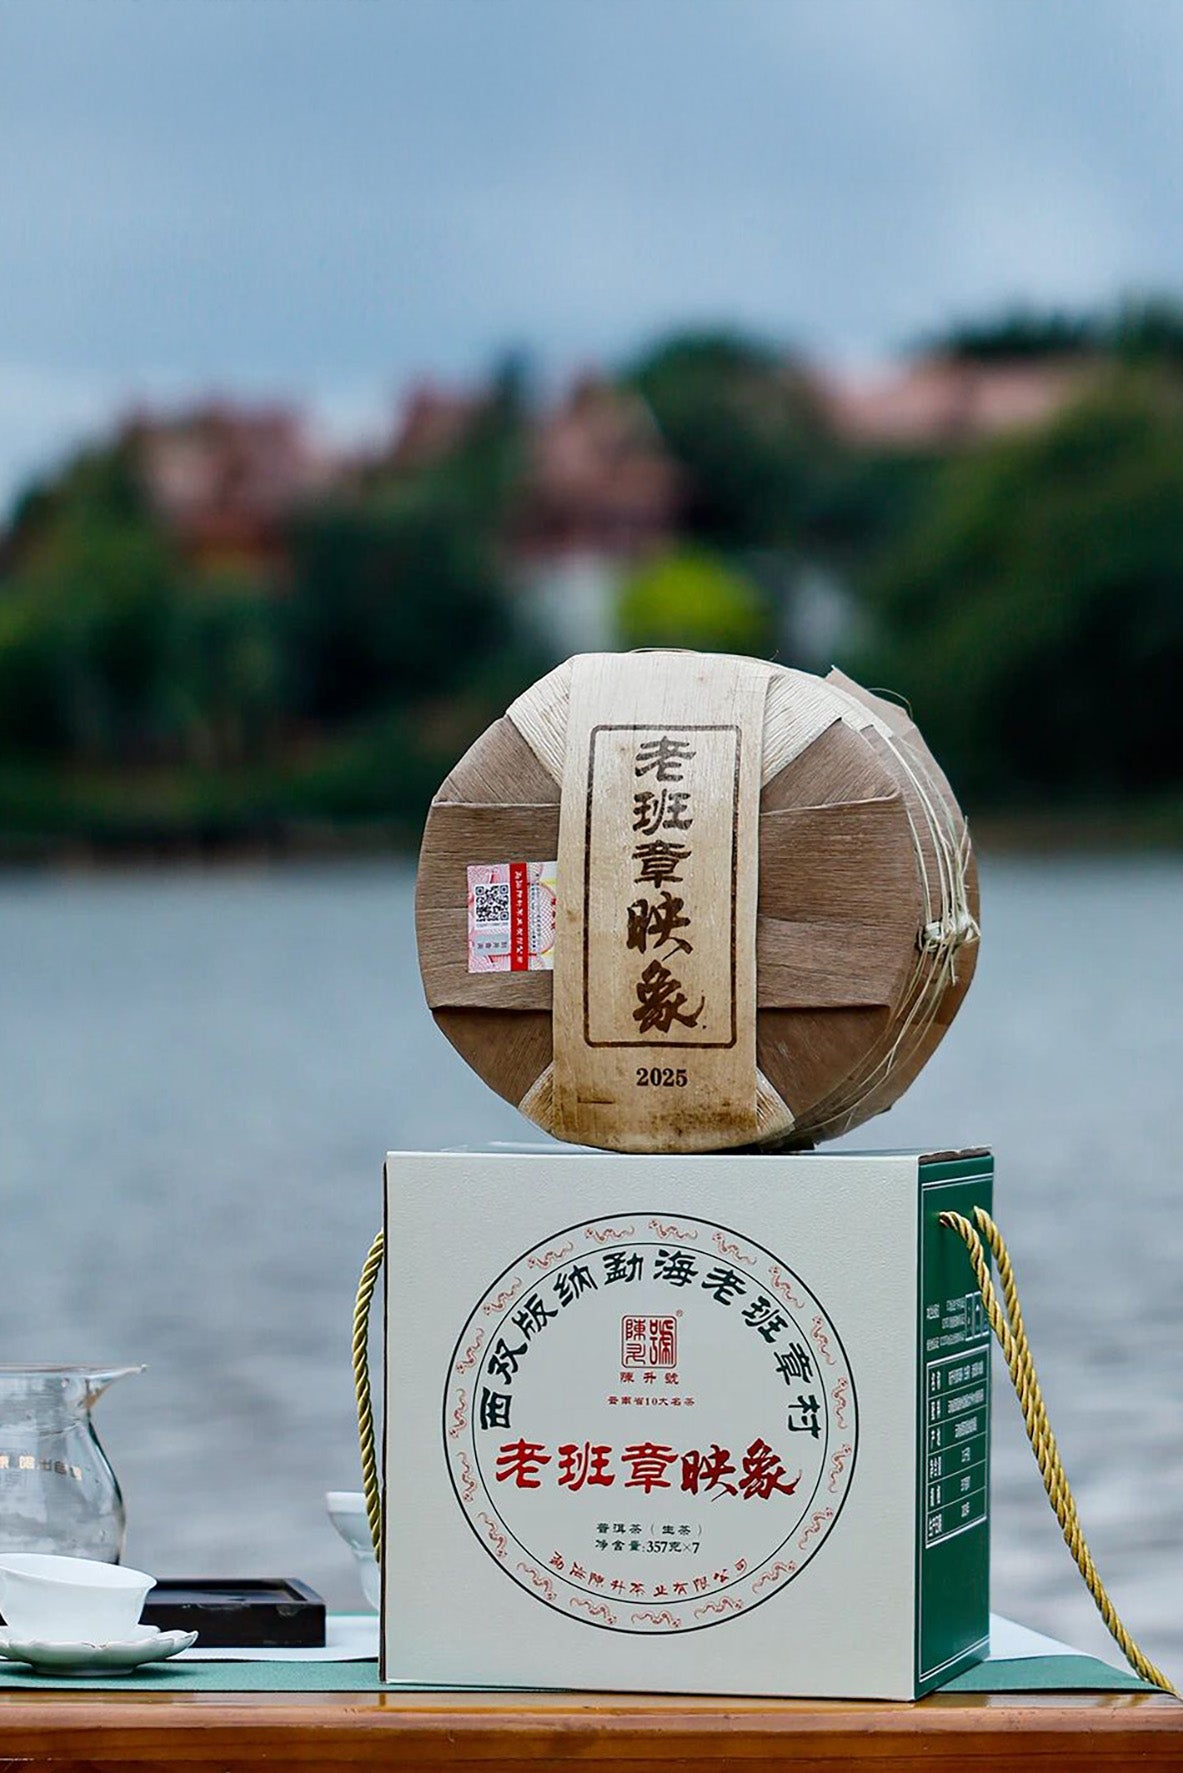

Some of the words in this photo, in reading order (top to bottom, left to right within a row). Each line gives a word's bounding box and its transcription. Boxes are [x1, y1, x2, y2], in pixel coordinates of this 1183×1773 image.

[625, 735, 705, 1034] 老班章映象
[636, 1067, 689, 1088] 2025
[480, 1248, 822, 1440] 西双版纳勐海老班章村
[495, 1437, 802, 1502] 老班章映象
